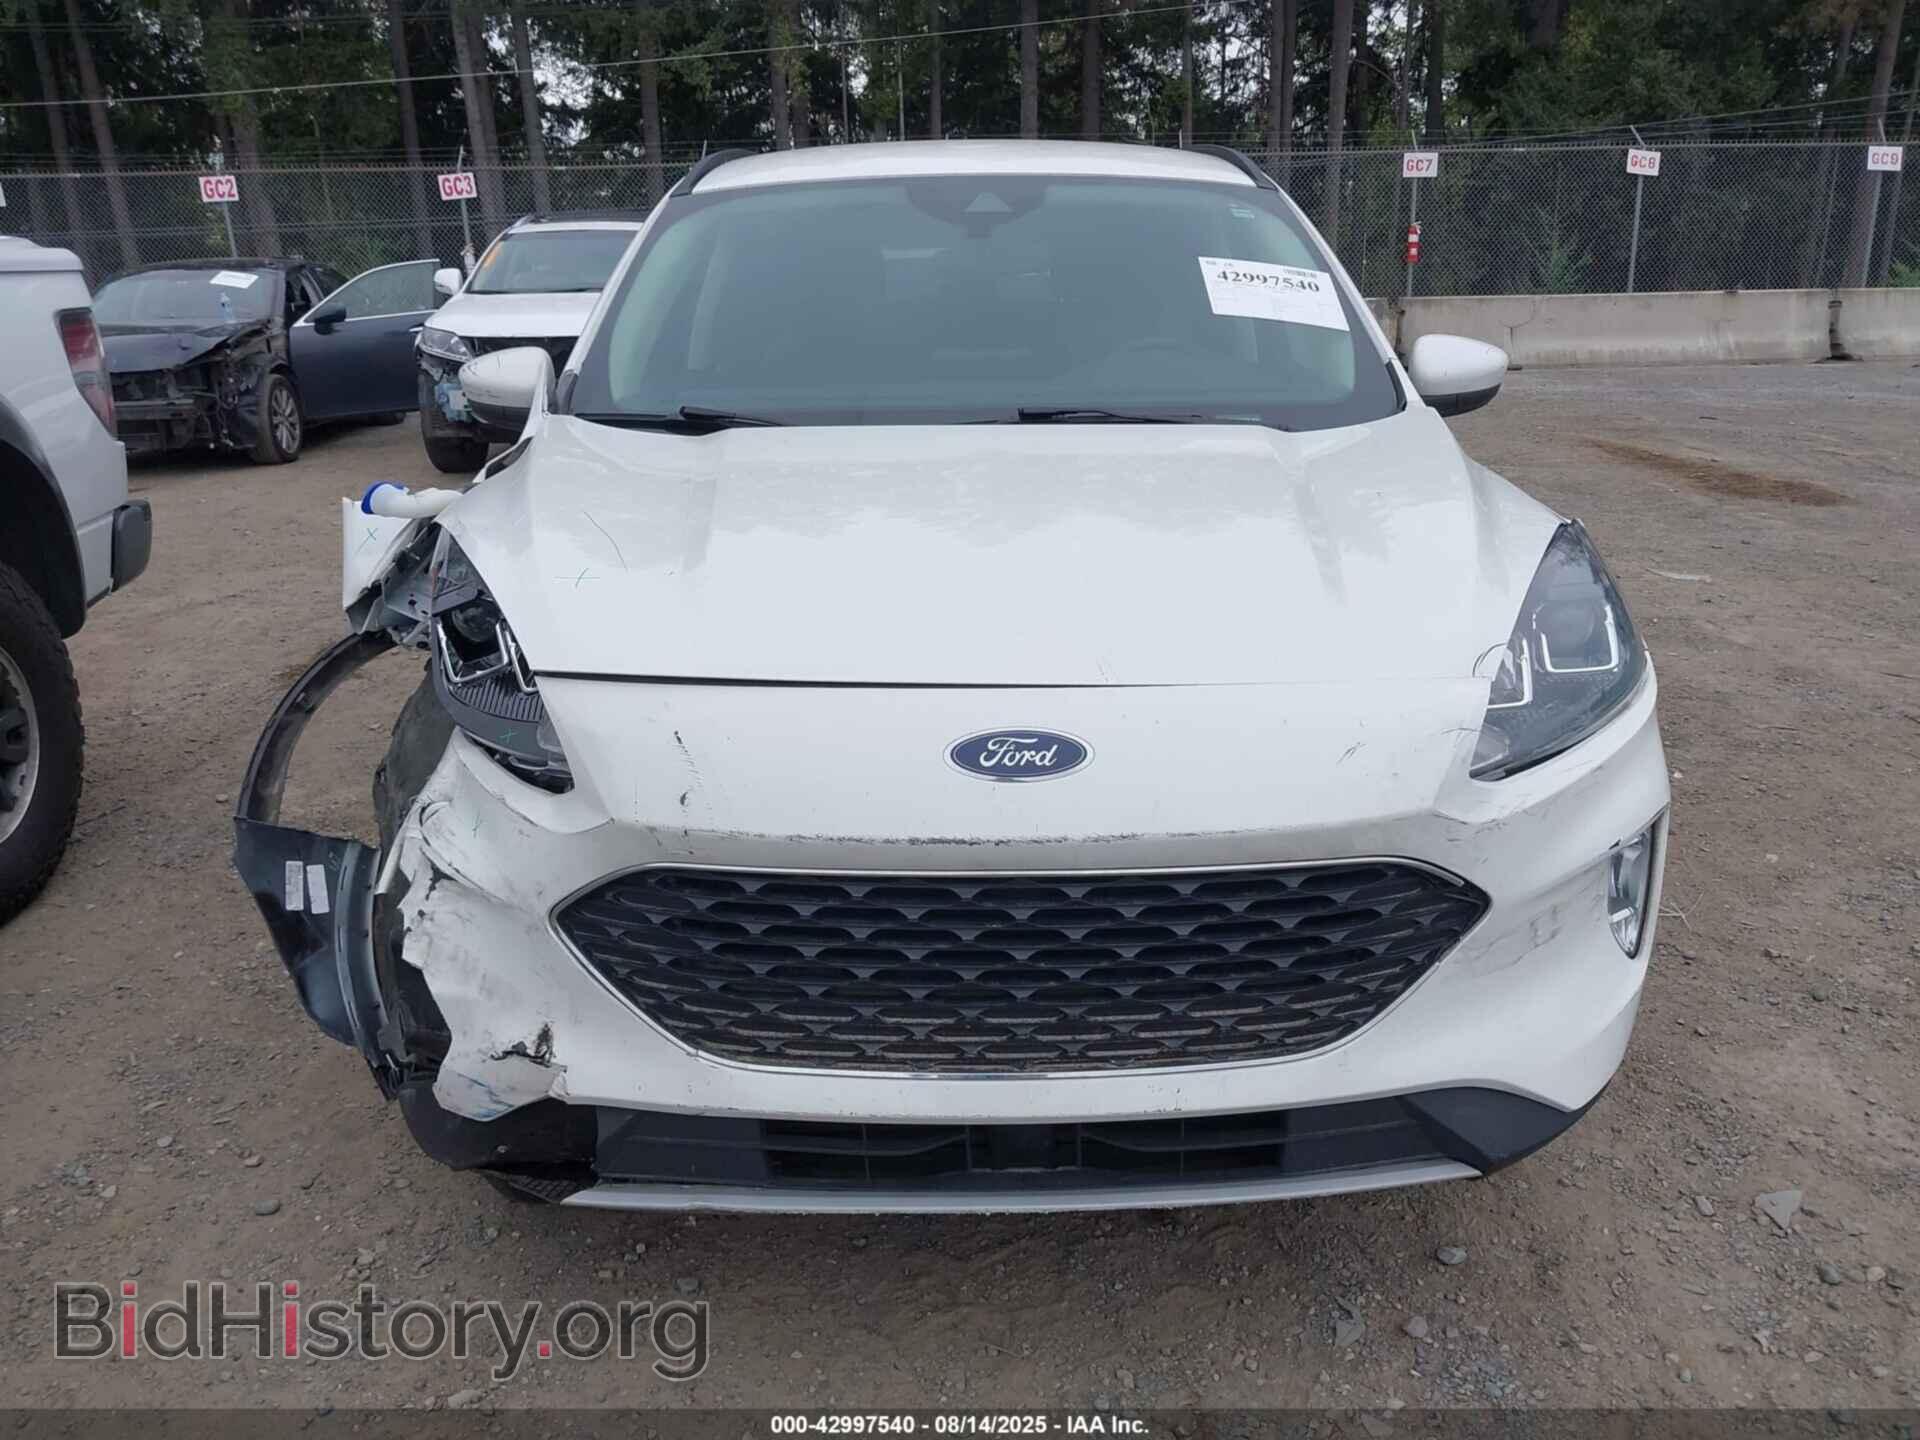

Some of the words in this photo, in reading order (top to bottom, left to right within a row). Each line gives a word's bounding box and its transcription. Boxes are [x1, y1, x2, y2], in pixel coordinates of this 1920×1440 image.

[1406, 158, 1433, 172] GC7
[203, 178, 236, 198] GC2
[441, 176, 474, 197] GC3
[1217, 269, 1320, 293] 42997540
[979, 736, 1058, 767] Ford
